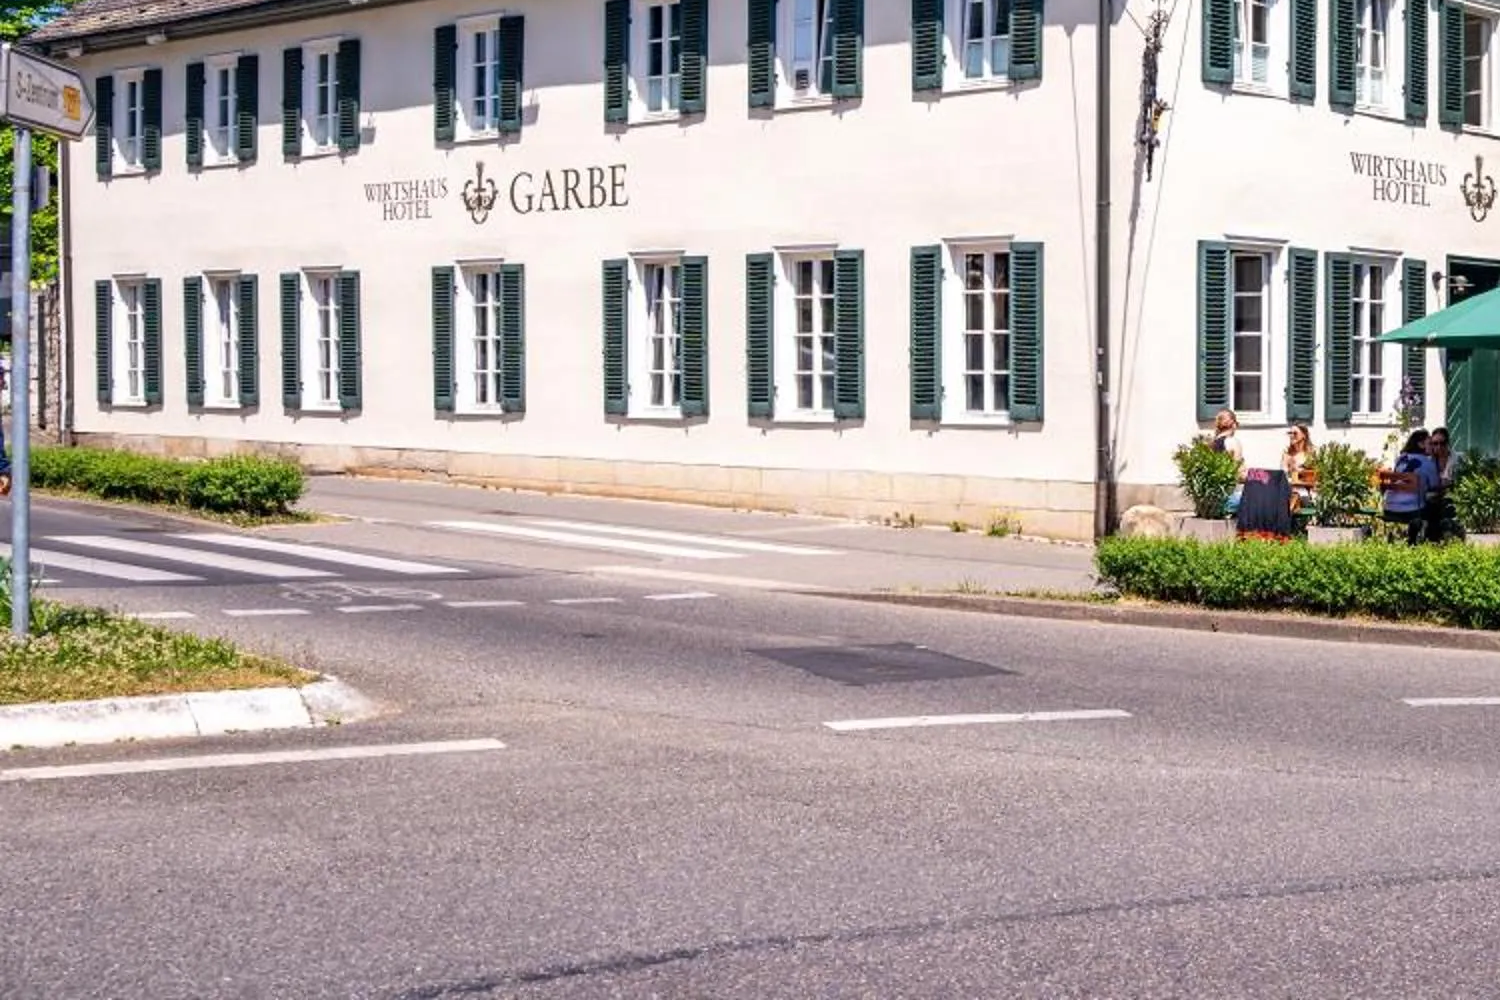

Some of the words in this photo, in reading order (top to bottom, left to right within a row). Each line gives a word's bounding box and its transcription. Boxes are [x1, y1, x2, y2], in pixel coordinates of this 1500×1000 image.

[1350, 151, 1447, 186] WIRTSHAUS
[364, 178, 449, 202] WIRTSHAUS
[510, 163, 630, 214] GARBE
[1373, 178, 1431, 207] HOTEL
[383, 199, 432, 221] HOTEL
